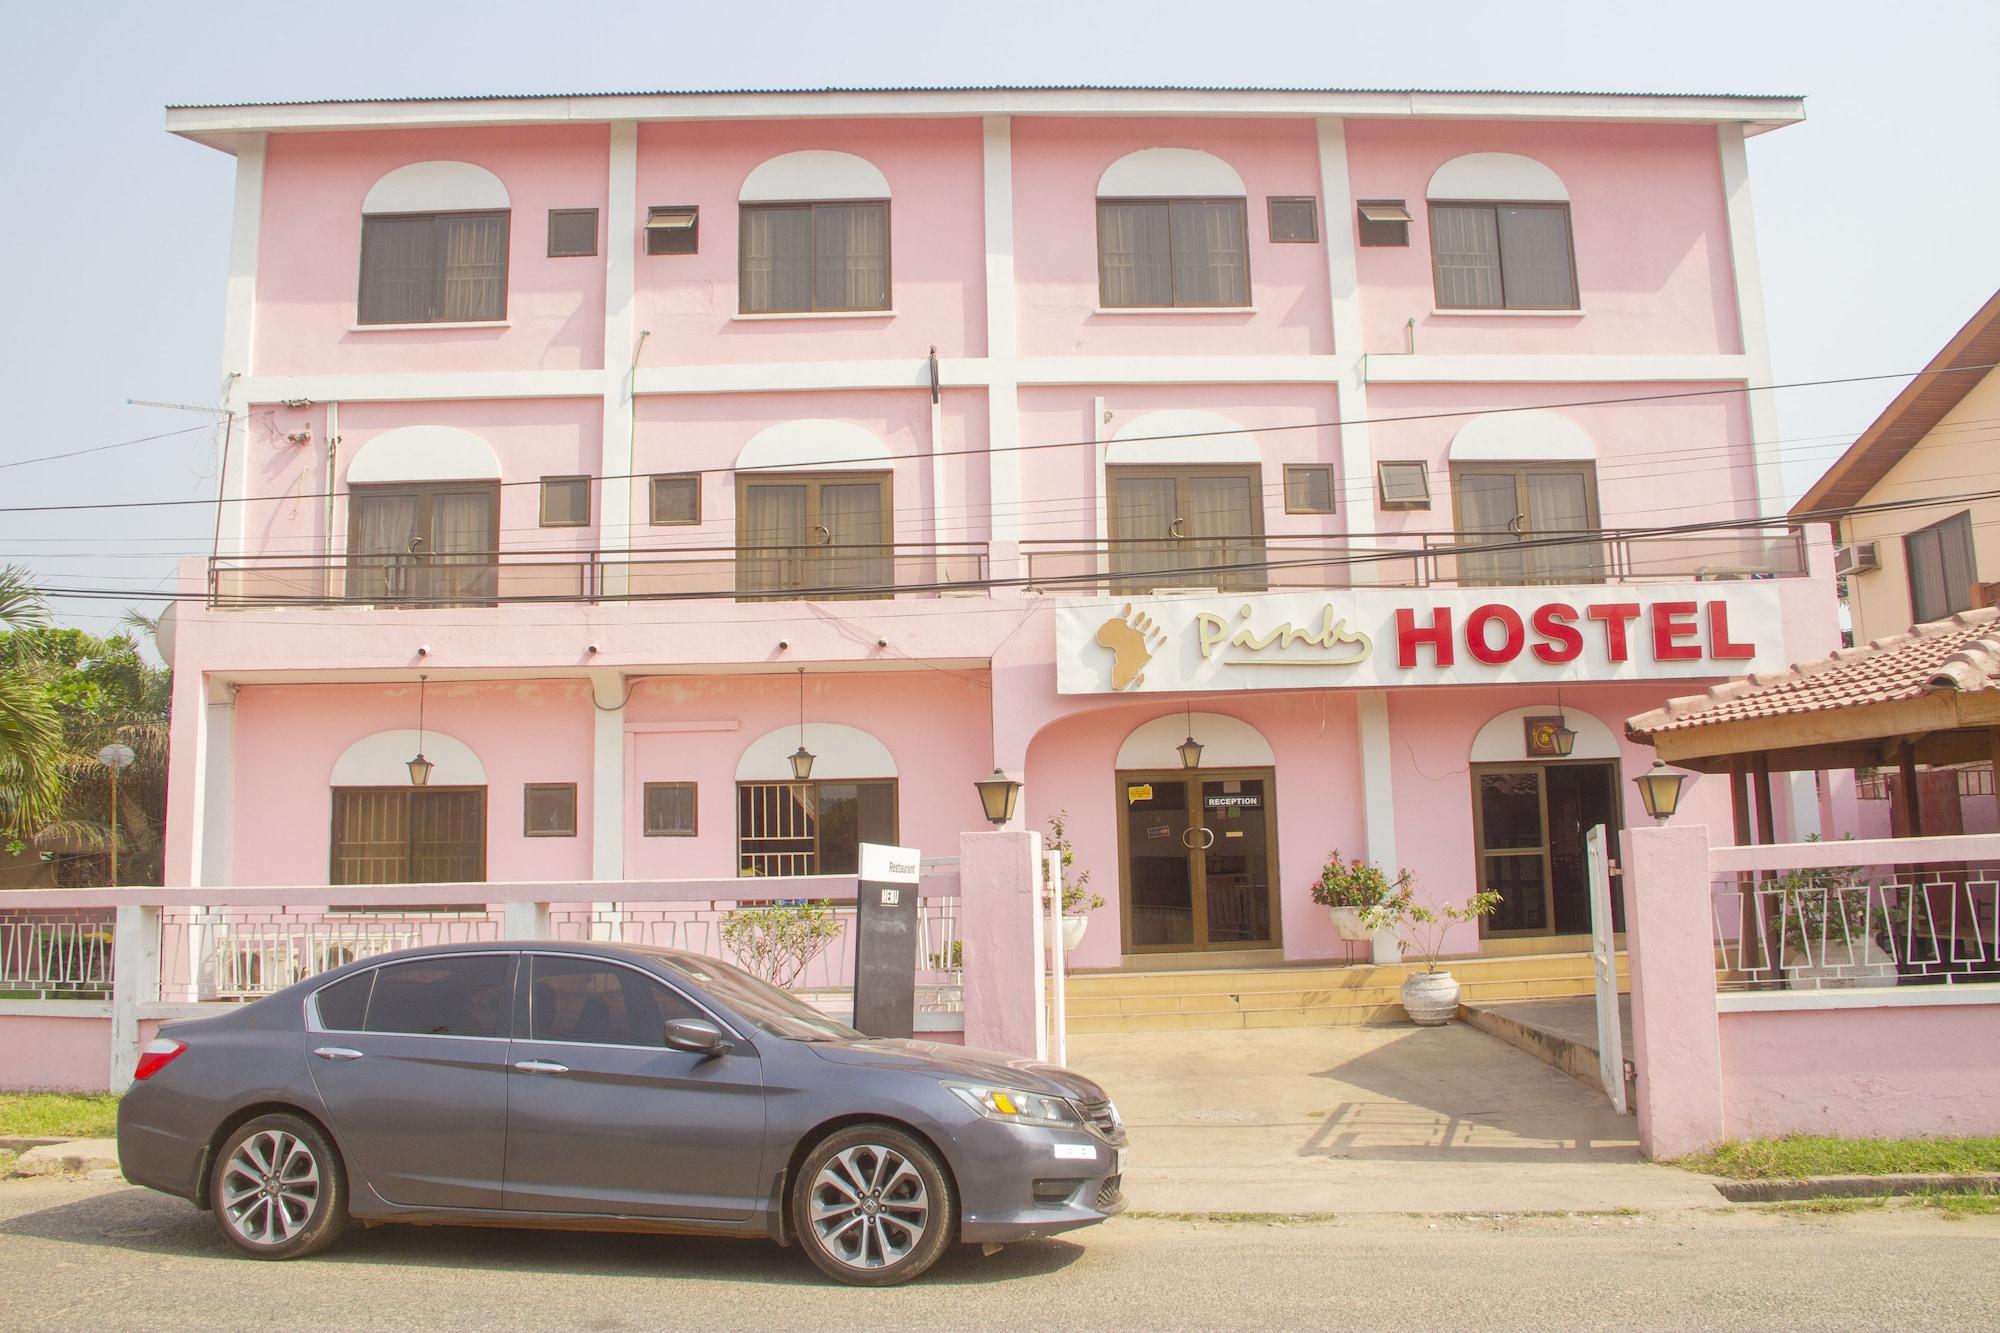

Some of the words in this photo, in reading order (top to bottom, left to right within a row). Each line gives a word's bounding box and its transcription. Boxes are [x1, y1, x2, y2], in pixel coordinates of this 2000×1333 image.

[1196, 603, 1373, 665] Pink
[1395, 600, 1756, 668] HOSTEL
[1208, 797, 1257, 806] RECEPTION
[889, 861, 916, 873] Restaurant
[882, 889, 899, 904] MENU
